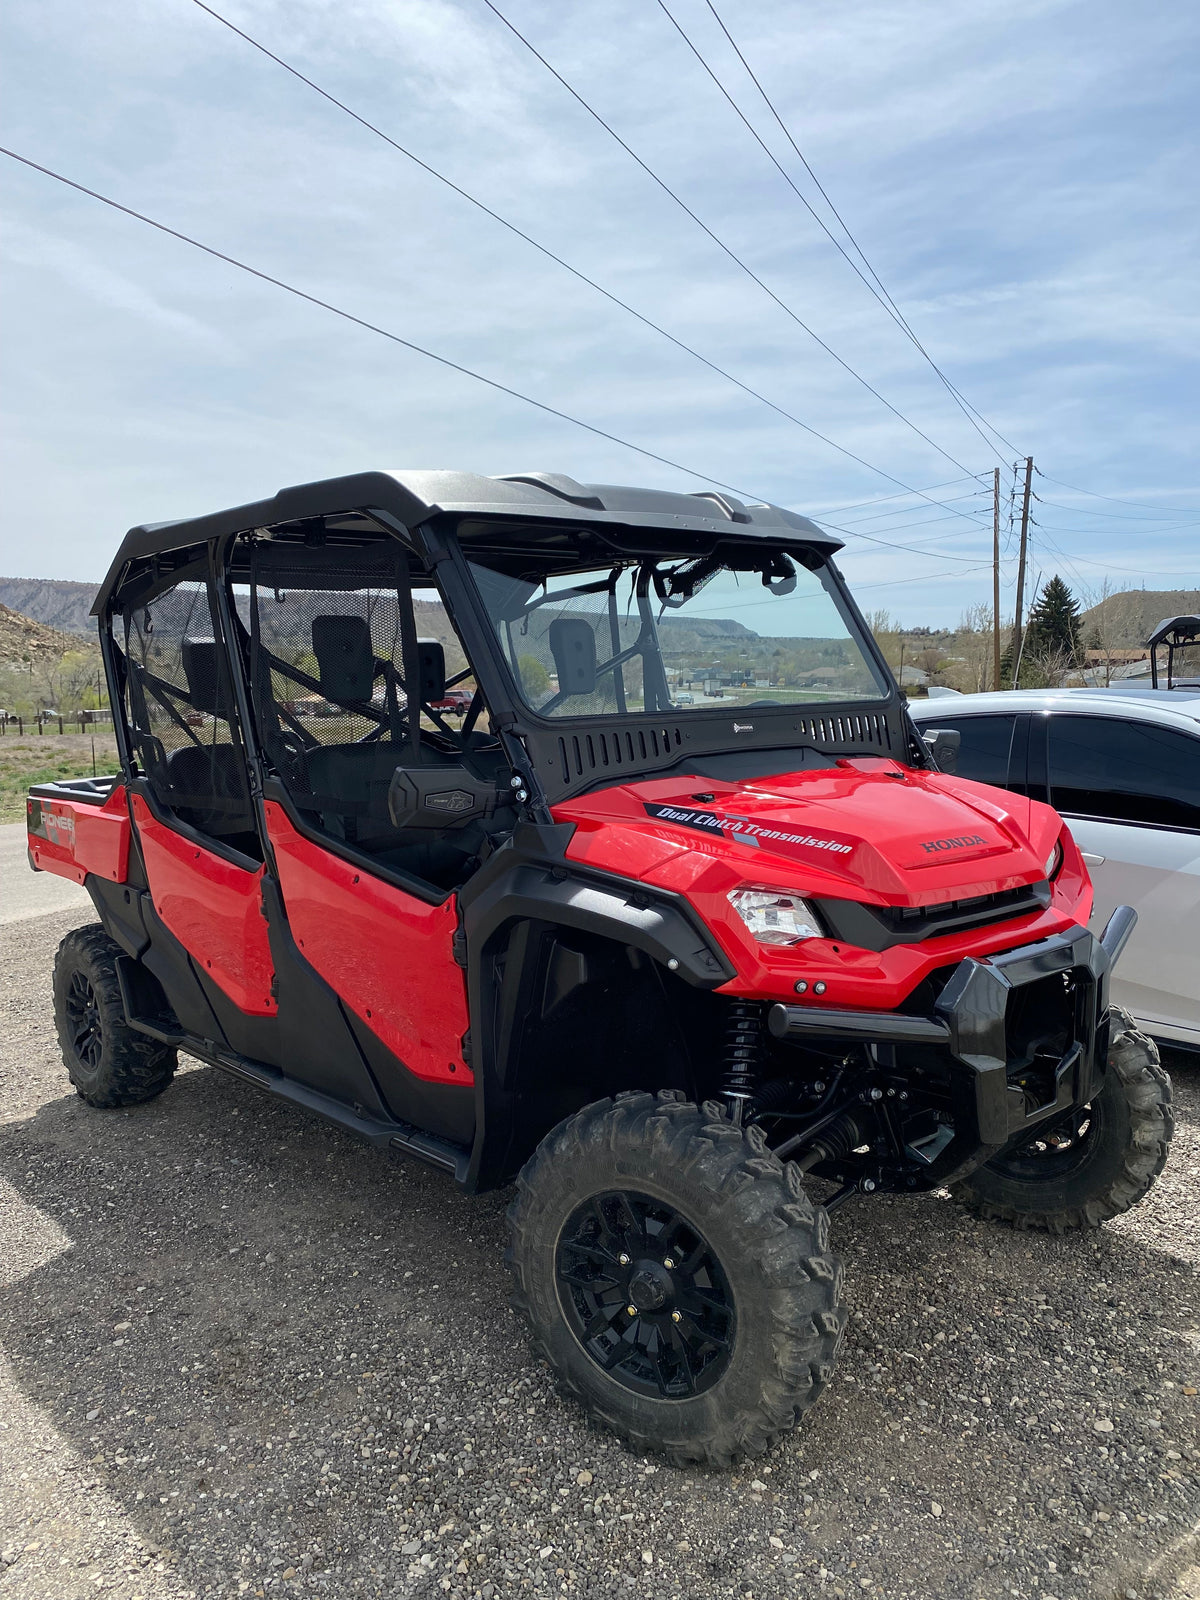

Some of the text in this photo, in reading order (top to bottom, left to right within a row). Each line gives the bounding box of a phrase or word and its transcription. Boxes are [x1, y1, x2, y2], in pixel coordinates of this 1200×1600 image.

[656, 808, 695, 822] Dual
[693, 814, 744, 831] Clutch
[743, 823, 853, 854] Transmission
[919, 835, 989, 853] HONDA
